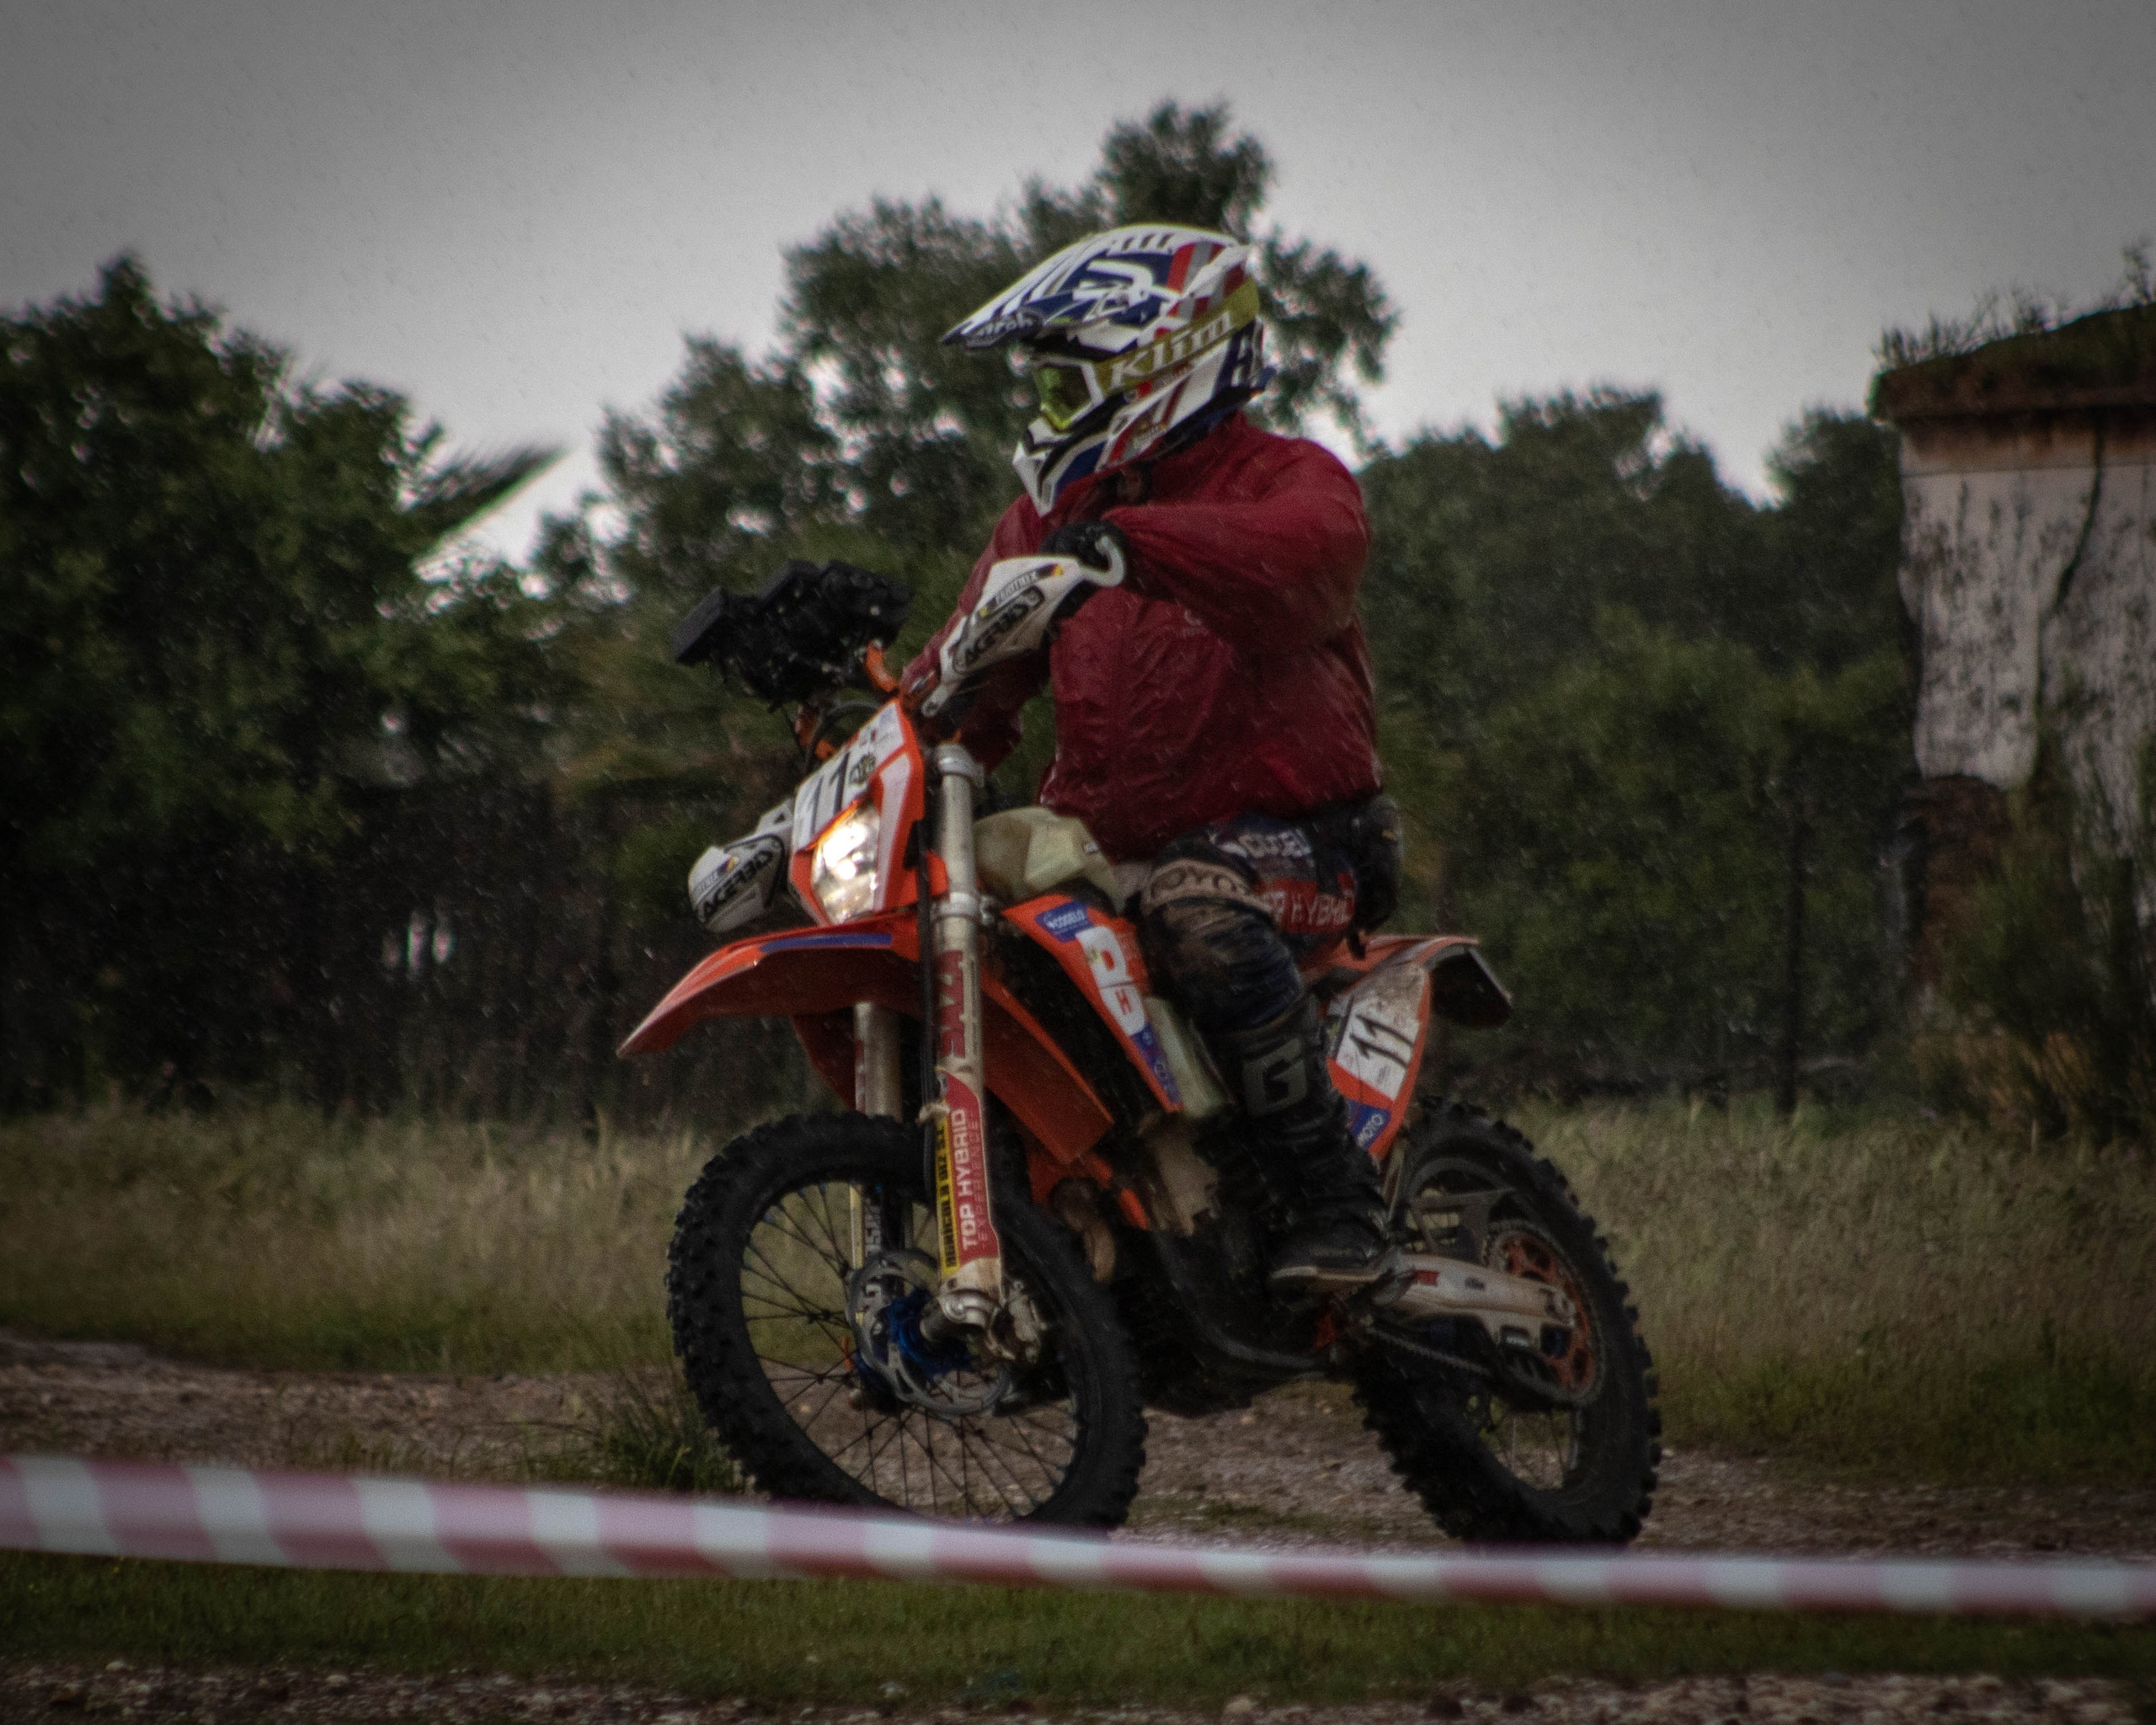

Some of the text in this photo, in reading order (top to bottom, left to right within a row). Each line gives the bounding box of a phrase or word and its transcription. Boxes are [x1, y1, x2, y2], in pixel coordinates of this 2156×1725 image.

[1348, 1013, 1414, 1070] 11
[950, 1108, 977, 1250] TOP HYBRID
